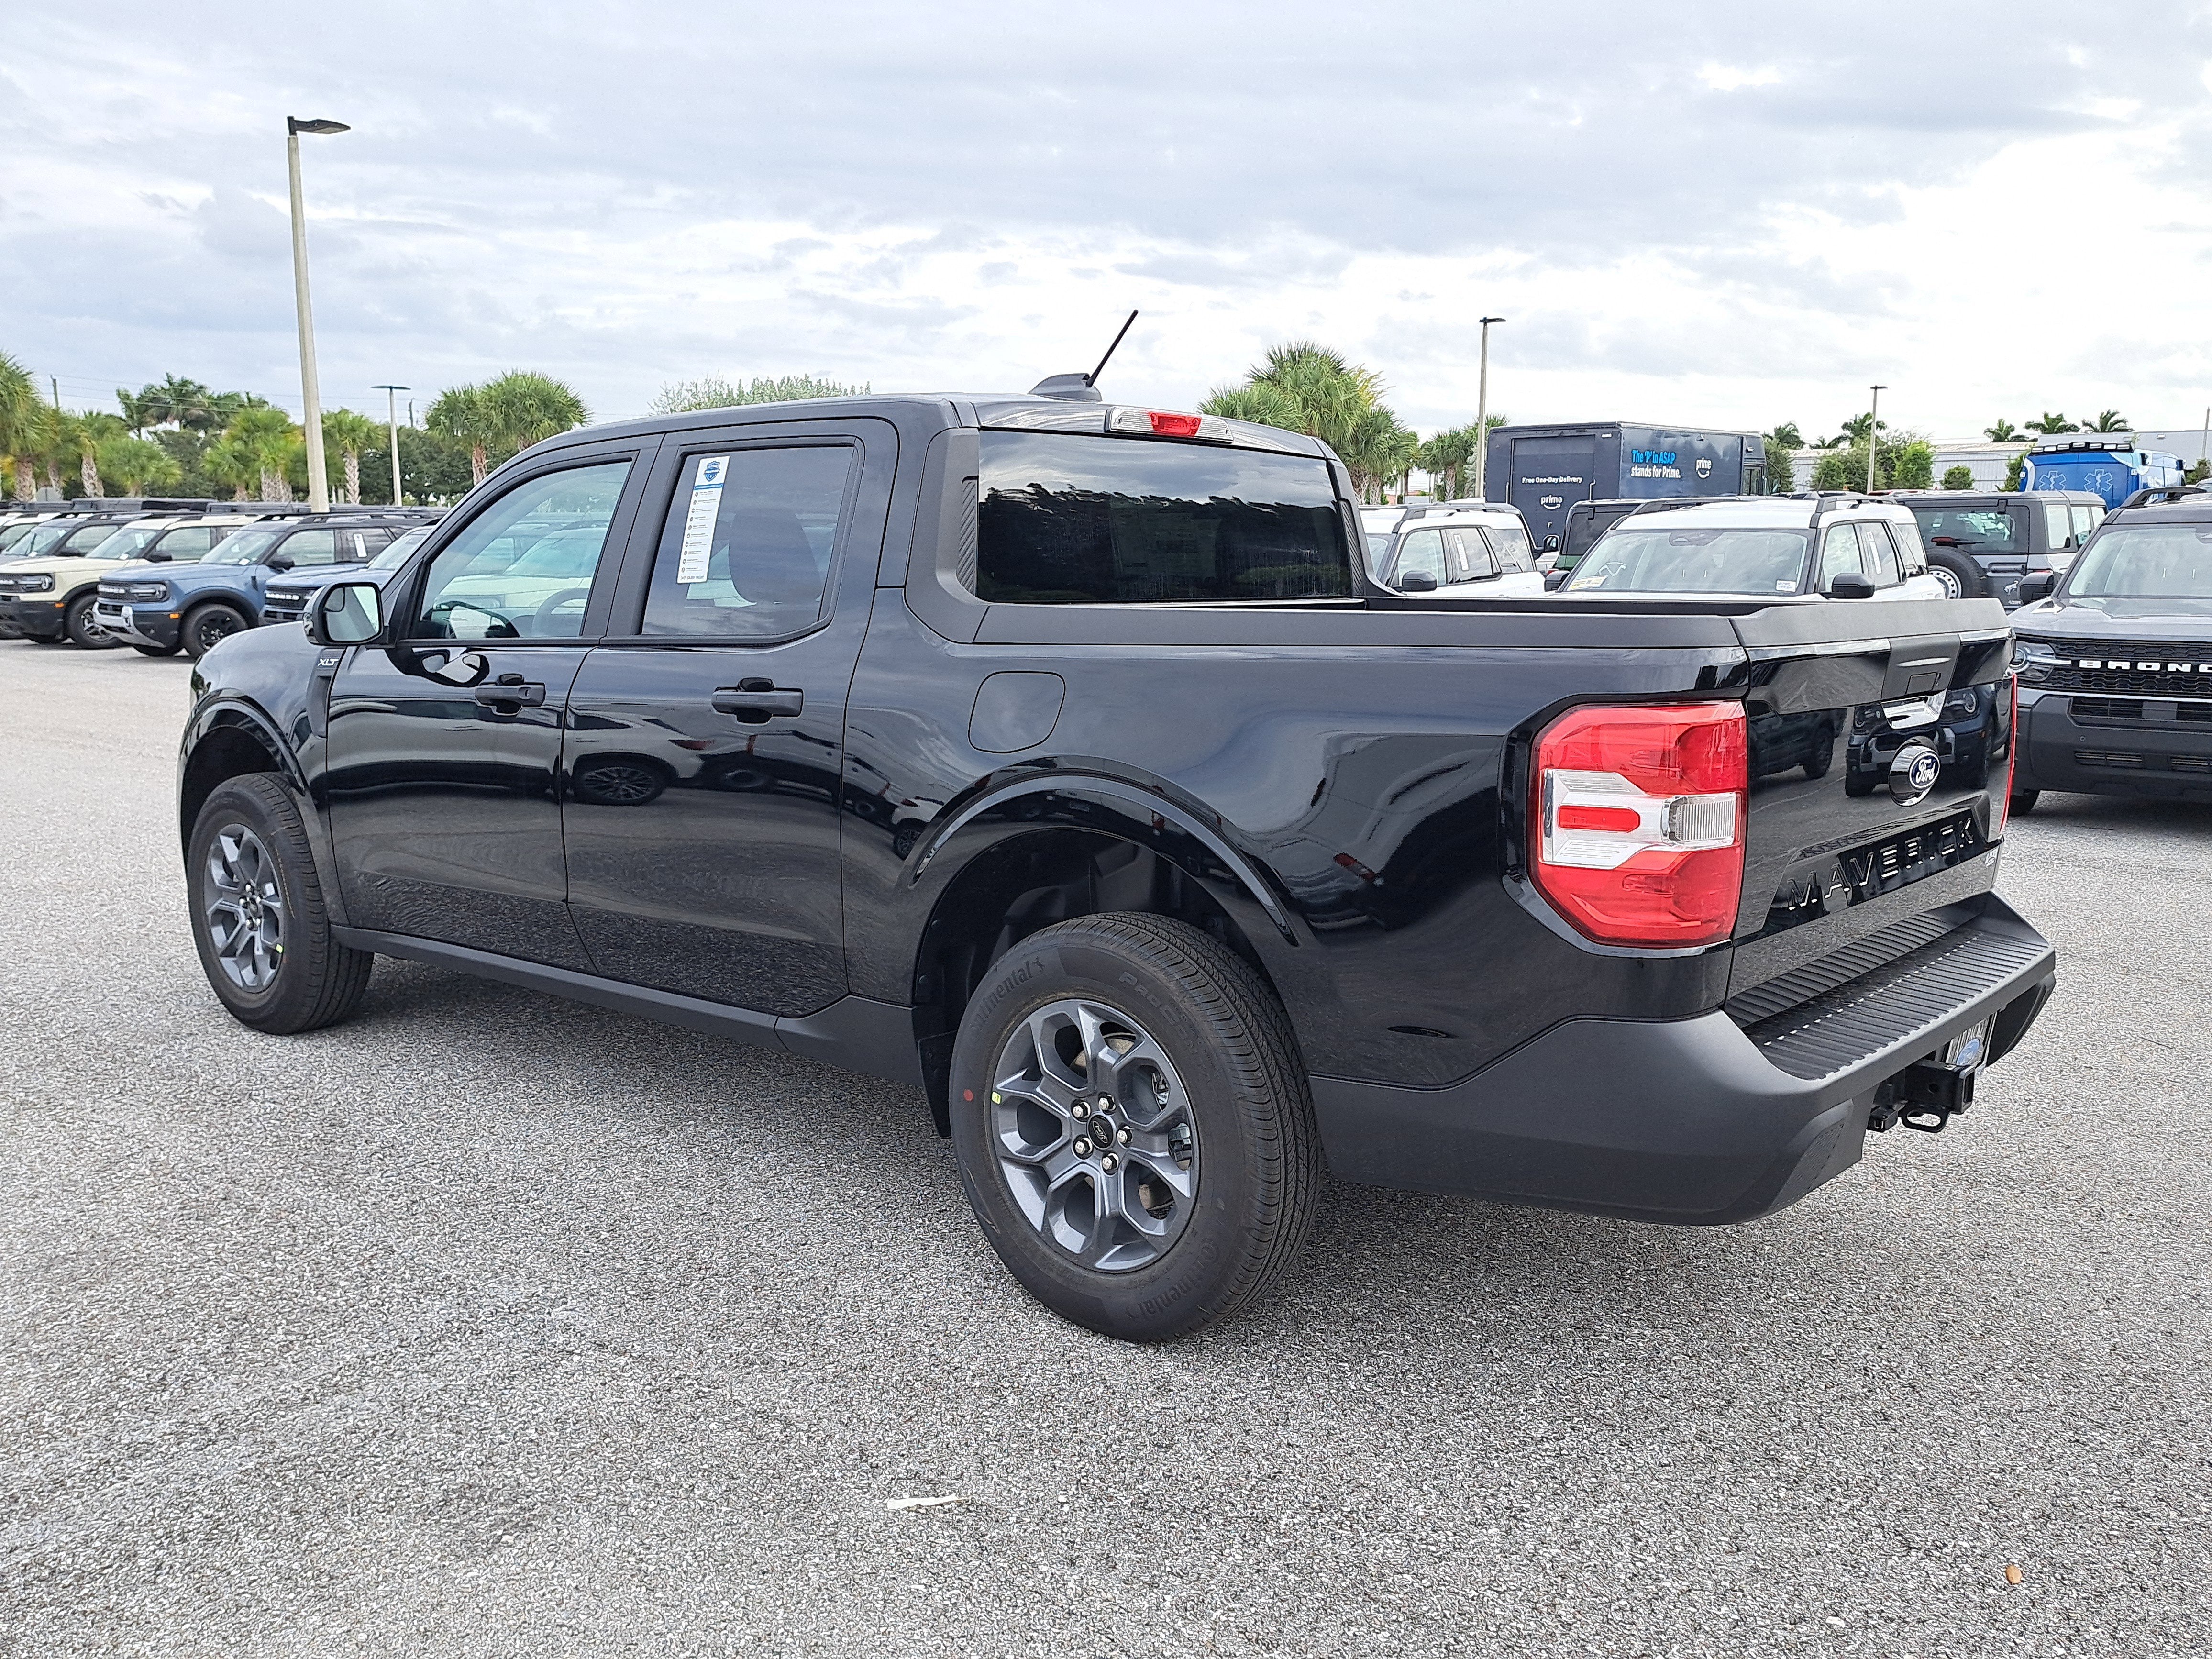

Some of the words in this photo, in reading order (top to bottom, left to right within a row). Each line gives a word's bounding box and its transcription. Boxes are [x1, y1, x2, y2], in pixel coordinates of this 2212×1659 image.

[1632, 450, 1644, 463] The
[1653, 451, 1659, 463] in
[1659, 452, 1676, 464] ASAP
[1696, 457, 1712, 471] prime
[1631, 465, 1652, 477] stands
[1652, 465, 1662, 477] for
[318, 658, 339, 666] XLT
[1915, 758, 1936, 784] Ford
[1787, 817, 1974, 911] MAVERICK
